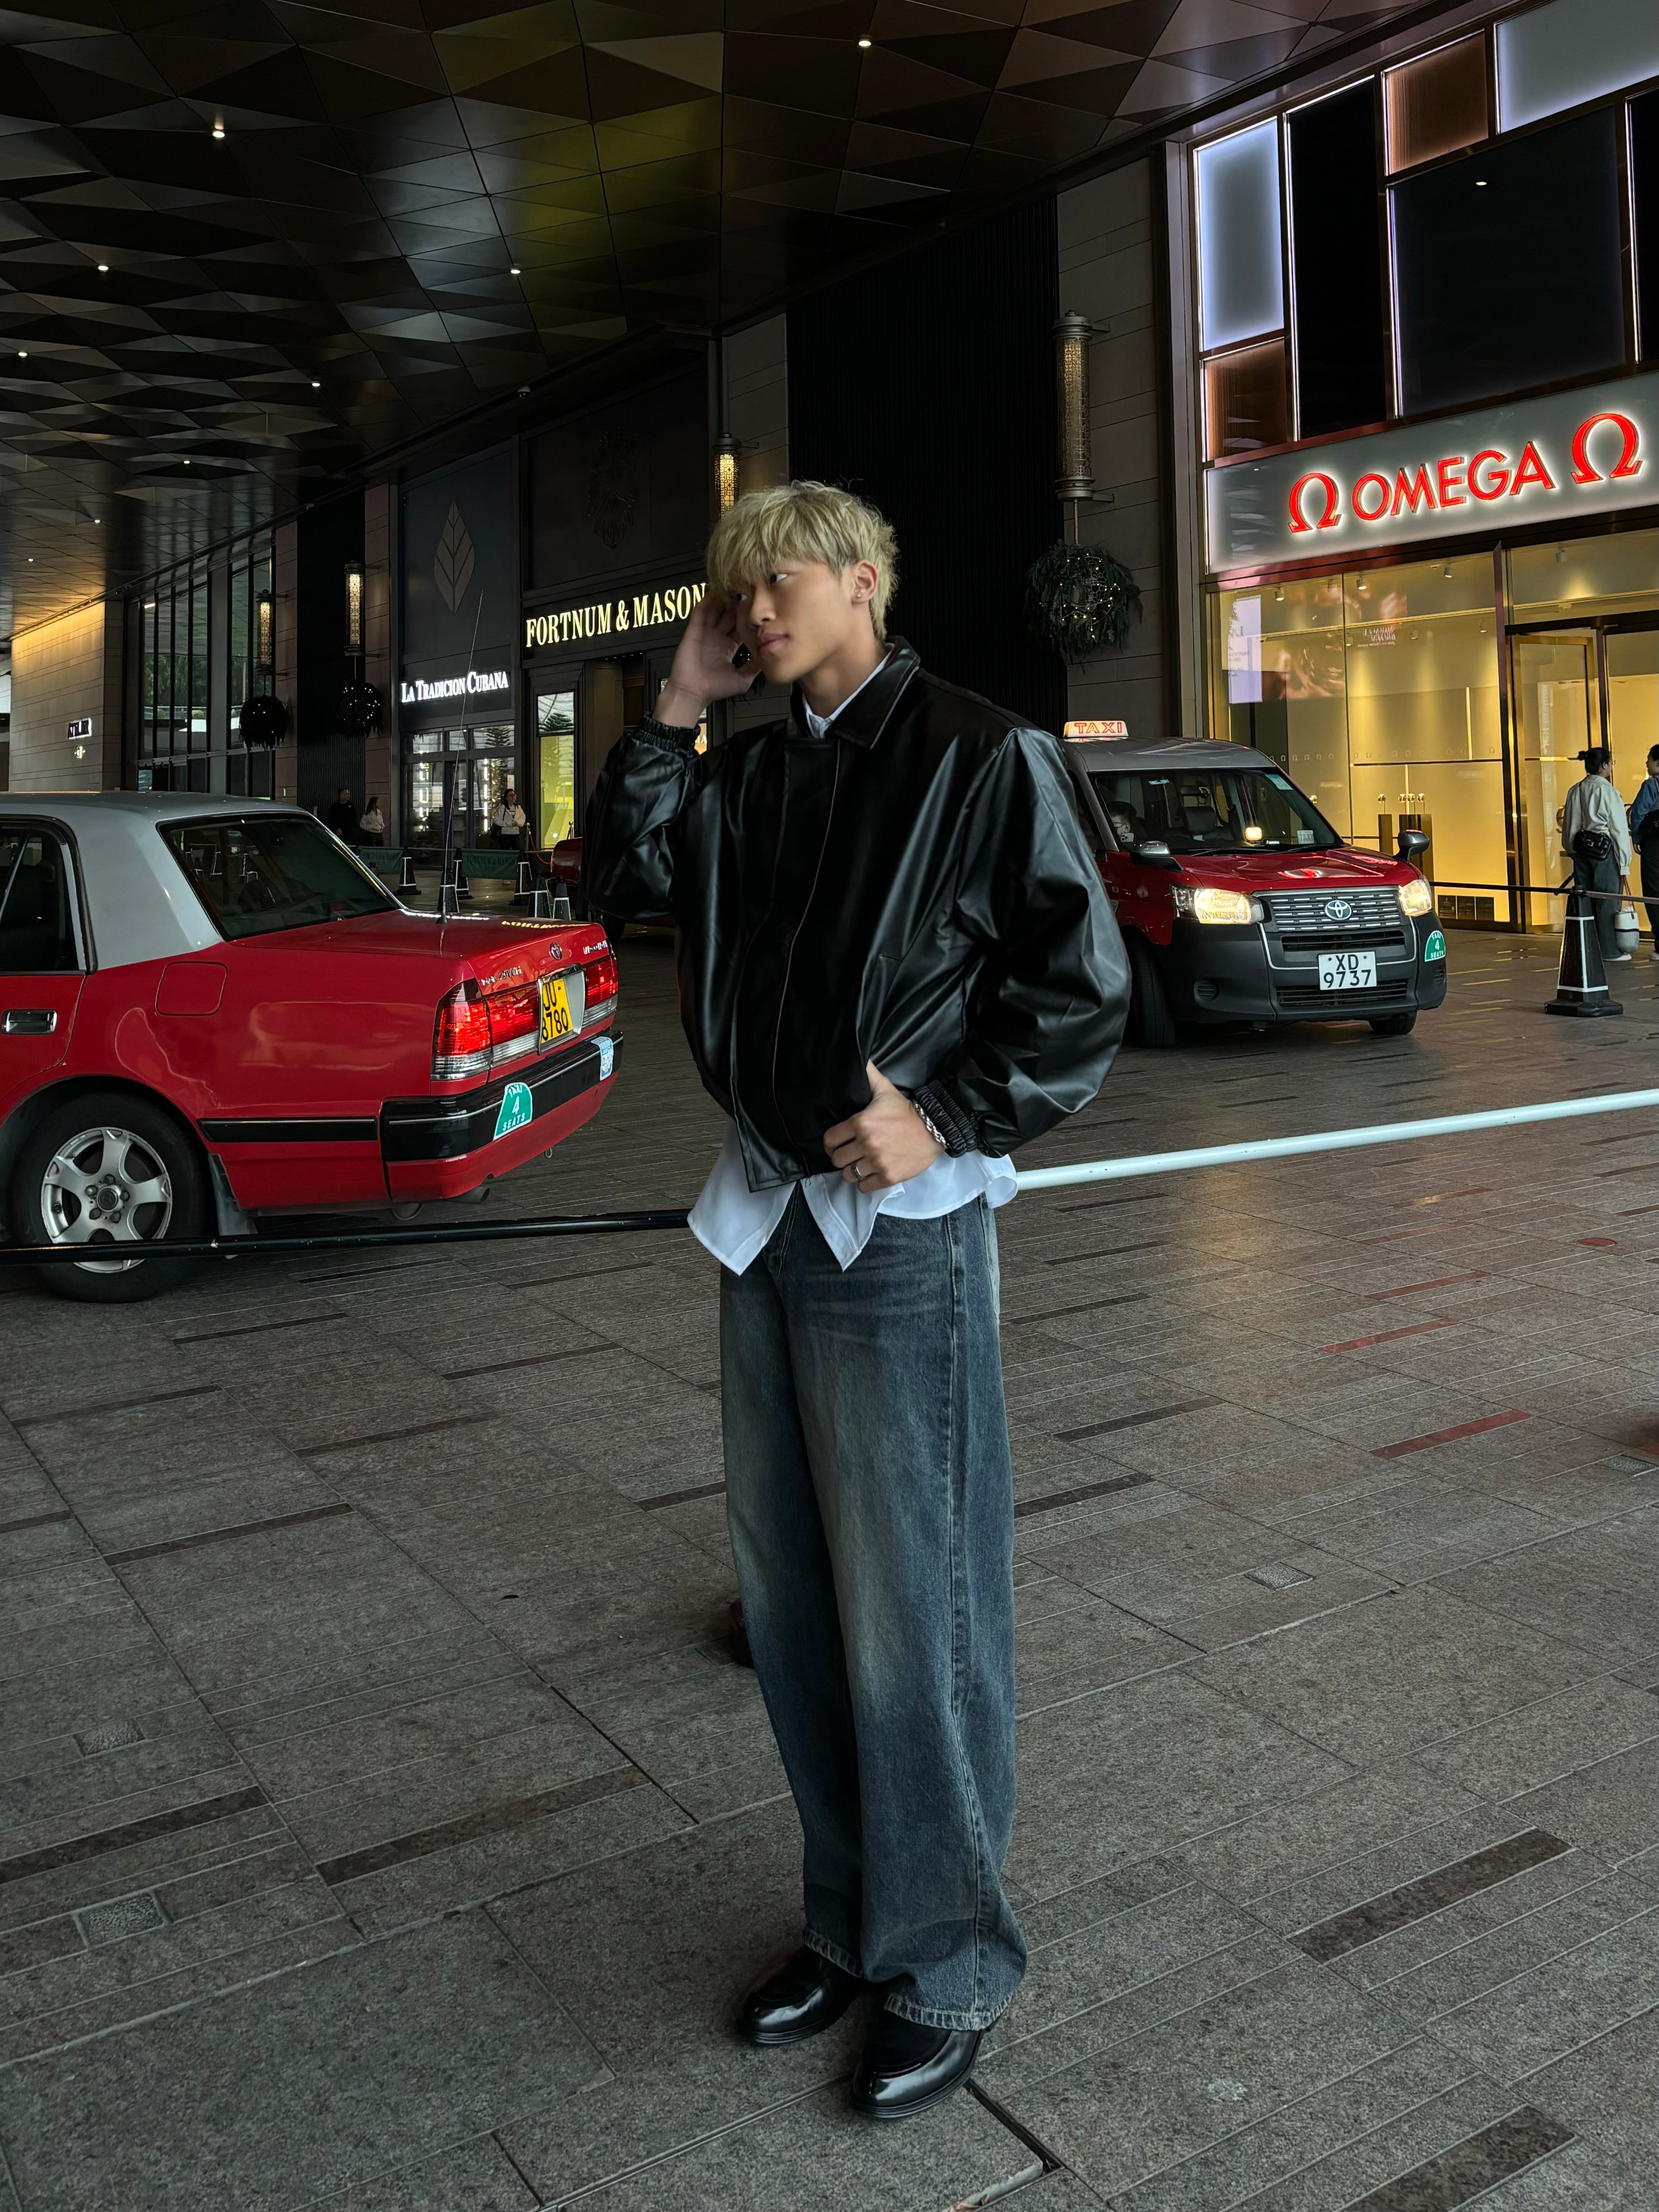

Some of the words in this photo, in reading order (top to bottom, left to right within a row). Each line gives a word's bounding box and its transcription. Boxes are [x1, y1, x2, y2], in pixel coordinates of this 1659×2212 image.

[1353, 441, 1556, 521] OMEGA
[526, 603, 612, 647] FORTNUM
[616, 600, 629, 631] &
[1075, 722, 1122, 734] TAXI
[1435, 940, 1439, 950] 4
[1335, 954, 1358, 971] XD
[1430, 950, 1444, 958] SEATS
[1324, 969, 1371, 988] 9737
[508, 1084, 523, 1098] TAXI
[512, 1096, 519, 1114] 4
[502, 1113, 525, 1131] SEATS
